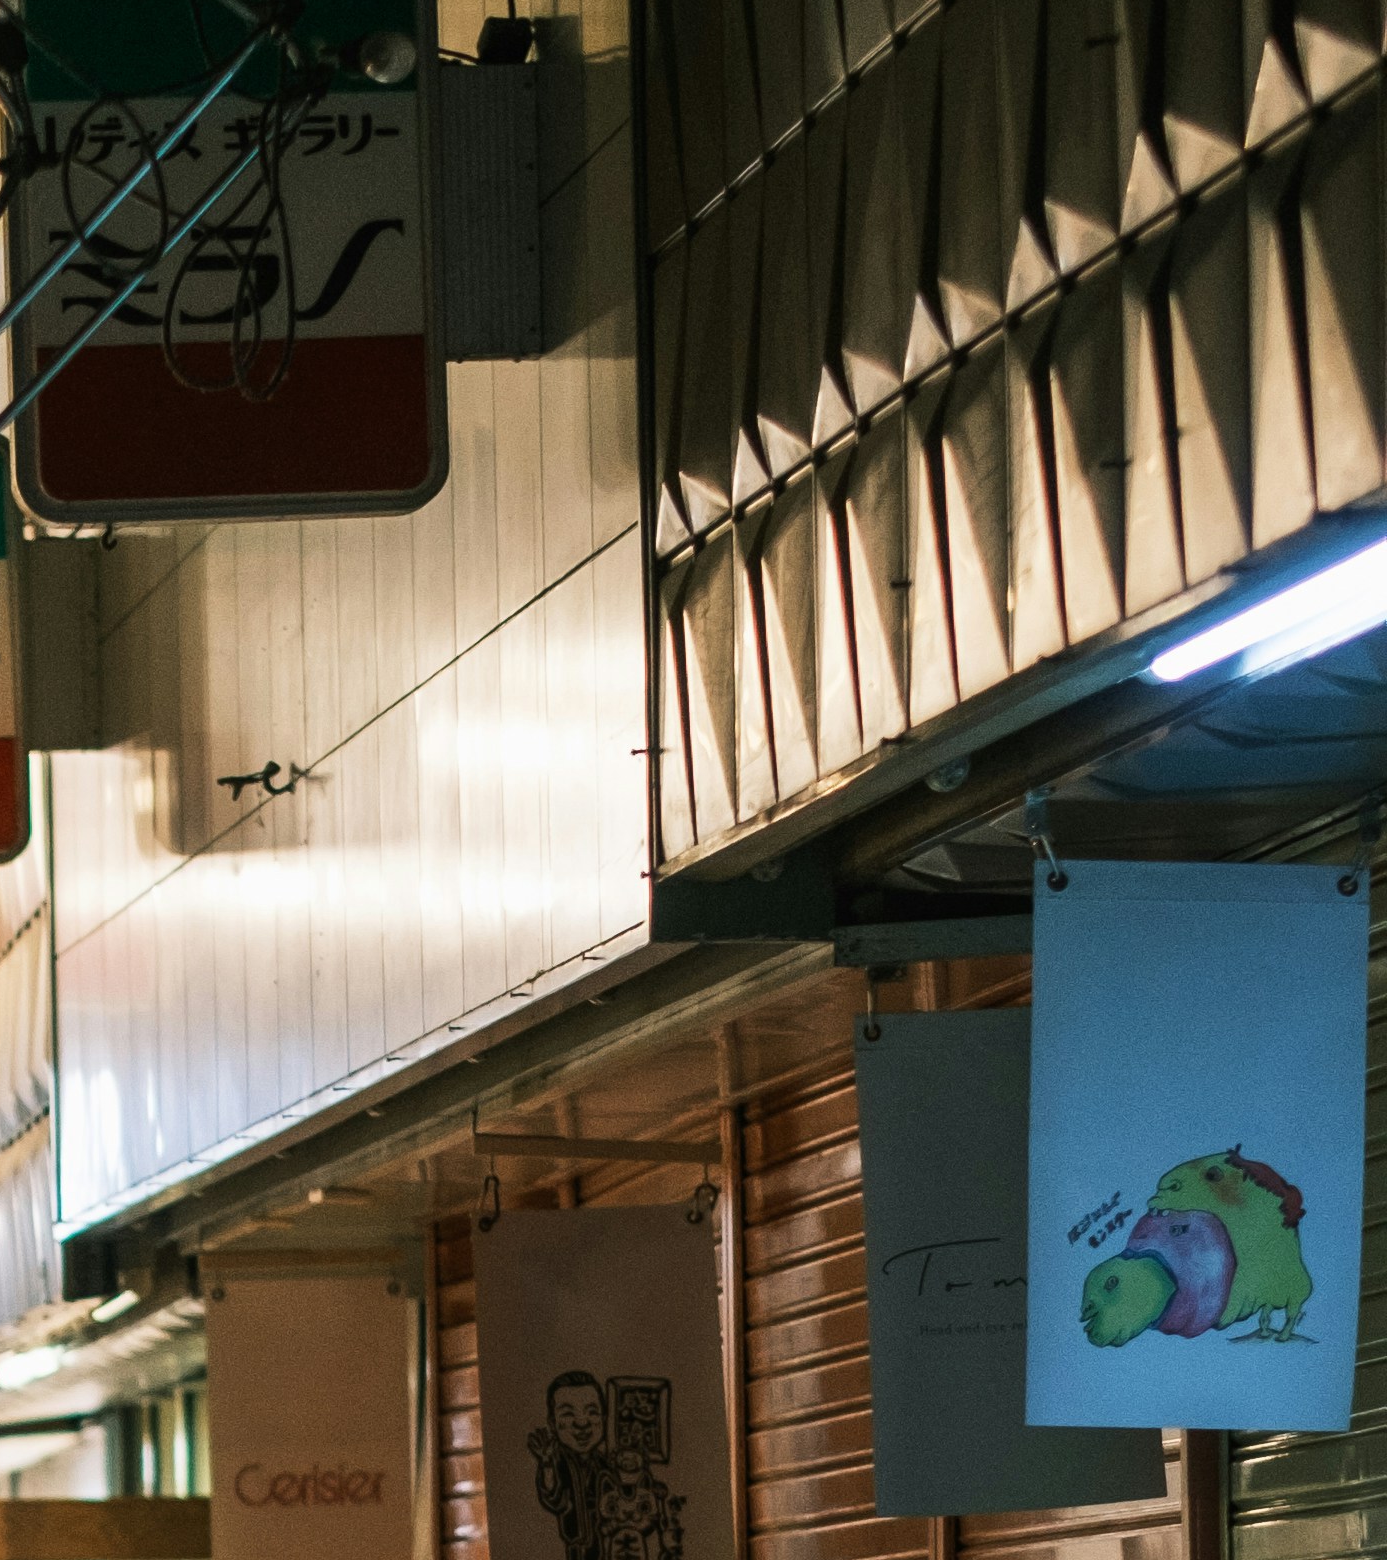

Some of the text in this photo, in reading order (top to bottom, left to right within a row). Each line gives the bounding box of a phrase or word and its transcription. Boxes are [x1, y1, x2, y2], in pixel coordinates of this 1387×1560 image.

[49, 218, 405, 327] ミラノ
[235, 1463, 386, 1508] Cerisier
